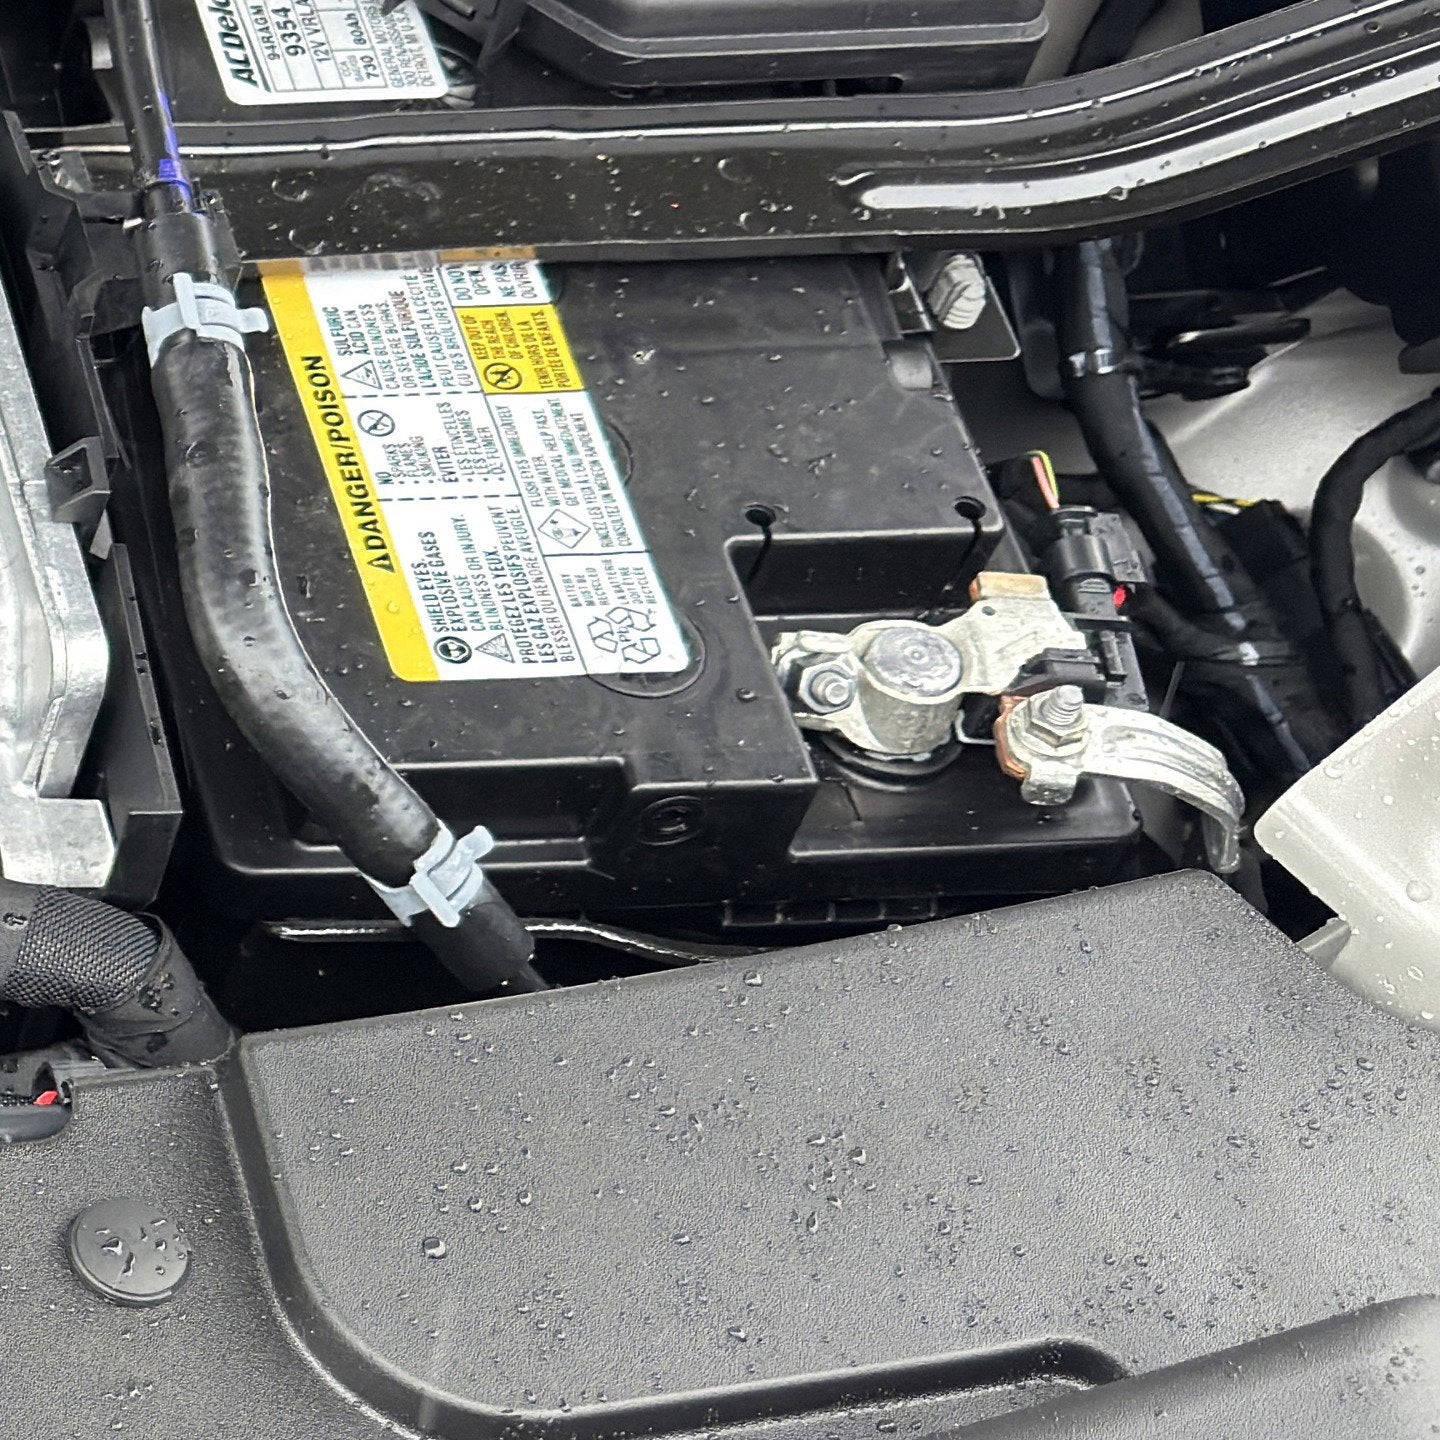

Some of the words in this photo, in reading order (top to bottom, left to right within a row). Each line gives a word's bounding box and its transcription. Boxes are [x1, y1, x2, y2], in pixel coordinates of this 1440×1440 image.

[271, 7, 306, 56] 9354
[344, 13, 367, 45] 80Ah
[363, 5, 388, 44] MOTORS
[310, 40, 331, 63] 12V
[359, 55, 379, 79] 730
[380, 46, 404, 88] GENERAL
[453, 287, 473, 300] DO
[498, 285, 517, 297] NE
[344, 309, 361, 328] CAN
[388, 291, 423, 349] SULFURIQUE
[416, 308, 433, 321] LA
[461, 314, 477, 324] OF
[516, 320, 533, 331] LA
[322, 307, 353, 356] SULFURIC
[358, 304, 388, 356] BLINDNESS
[465, 326, 483, 340] OUT
[520, 332, 537, 343] DE
[348, 331, 370, 355] ACID
[421, 323, 447, 361] CAUSER
[471, 342, 489, 360] KEEP
[543, 347, 560, 358] DE
[387, 337, 412, 373] SEVERE
[449, 352, 468, 371] DES
[507, 350, 524, 360] OF
[525, 344, 544, 365] HORS
[377, 359, 400, 390] CAUSE
[401, 375, 418, 388] OR
[410, 353, 437, 388] L'ACIDE
[435, 364, 456, 387] PEUT
[533, 367, 553, 389] TENIR
[455, 410, 482, 455] FLAMMES
[476, 426, 500, 459] FUMER
[539, 431, 558, 452] HELP
[303, 356, 386, 550] DANGER/POISON
[382, 443, 407, 478] SPARKS
[396, 442, 421, 478] FLAMES
[409, 436, 436, 477] SMOKING
[456, 458, 475, 476] LES
[471, 457, 491, 475] LES
[515, 459, 534, 479] EYES
[550, 454, 572, 489] MEDICAL
[375, 471, 394, 485] NO
[523, 481, 544, 507] FLUSH
[544, 486, 561, 506] WITH
[561, 491, 580, 506] GET
[586, 506, 605, 520] LES
[487, 506, 516, 551] PEUVENT
[418, 531, 445, 567] GASES
[465, 556, 483, 571] OR
[504, 554, 539, 614] EXPLOSIFS
[523, 557, 550, 596] RENDRE
[432, 571, 467, 632] EXPLOSIVE
[453, 575, 478, 607] CAUSE
[471, 573, 504, 631] BLINDNESS
[494, 582, 516, 603] LES
[422, 594, 449, 632] SHIELD
[540, 599, 557, 614] OU
[467, 610, 486, 632] CAN
[526, 617, 549, 639] GAZ
[546, 616, 575, 662] BLESSER
[536, 643, 558, 663] LES
